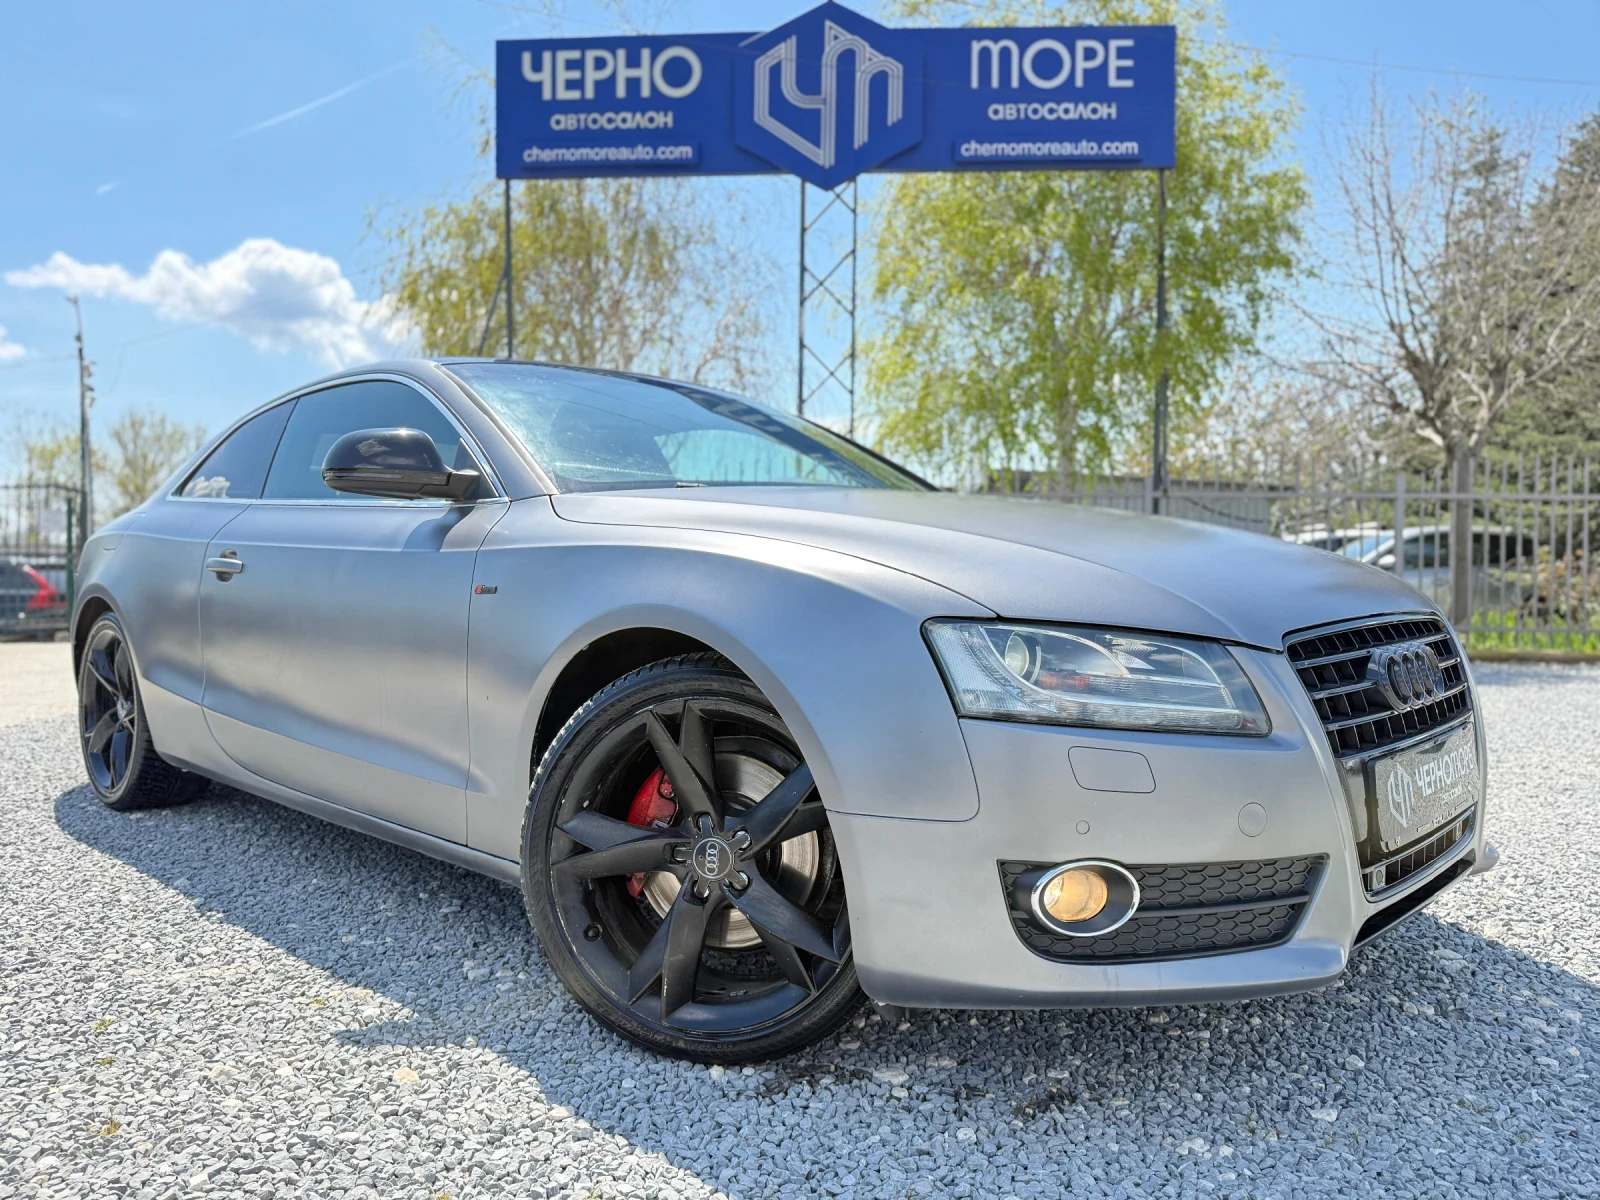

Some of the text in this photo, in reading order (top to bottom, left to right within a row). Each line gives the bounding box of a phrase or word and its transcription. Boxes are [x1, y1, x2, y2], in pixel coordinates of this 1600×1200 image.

[521, 46, 702, 101] ЧЕРНО
[970, 38, 1135, 89] МОРЕ
[523, 144, 693, 163] chernomoreauto.com
[960, 140, 1139, 157] chernomoreauto.com
